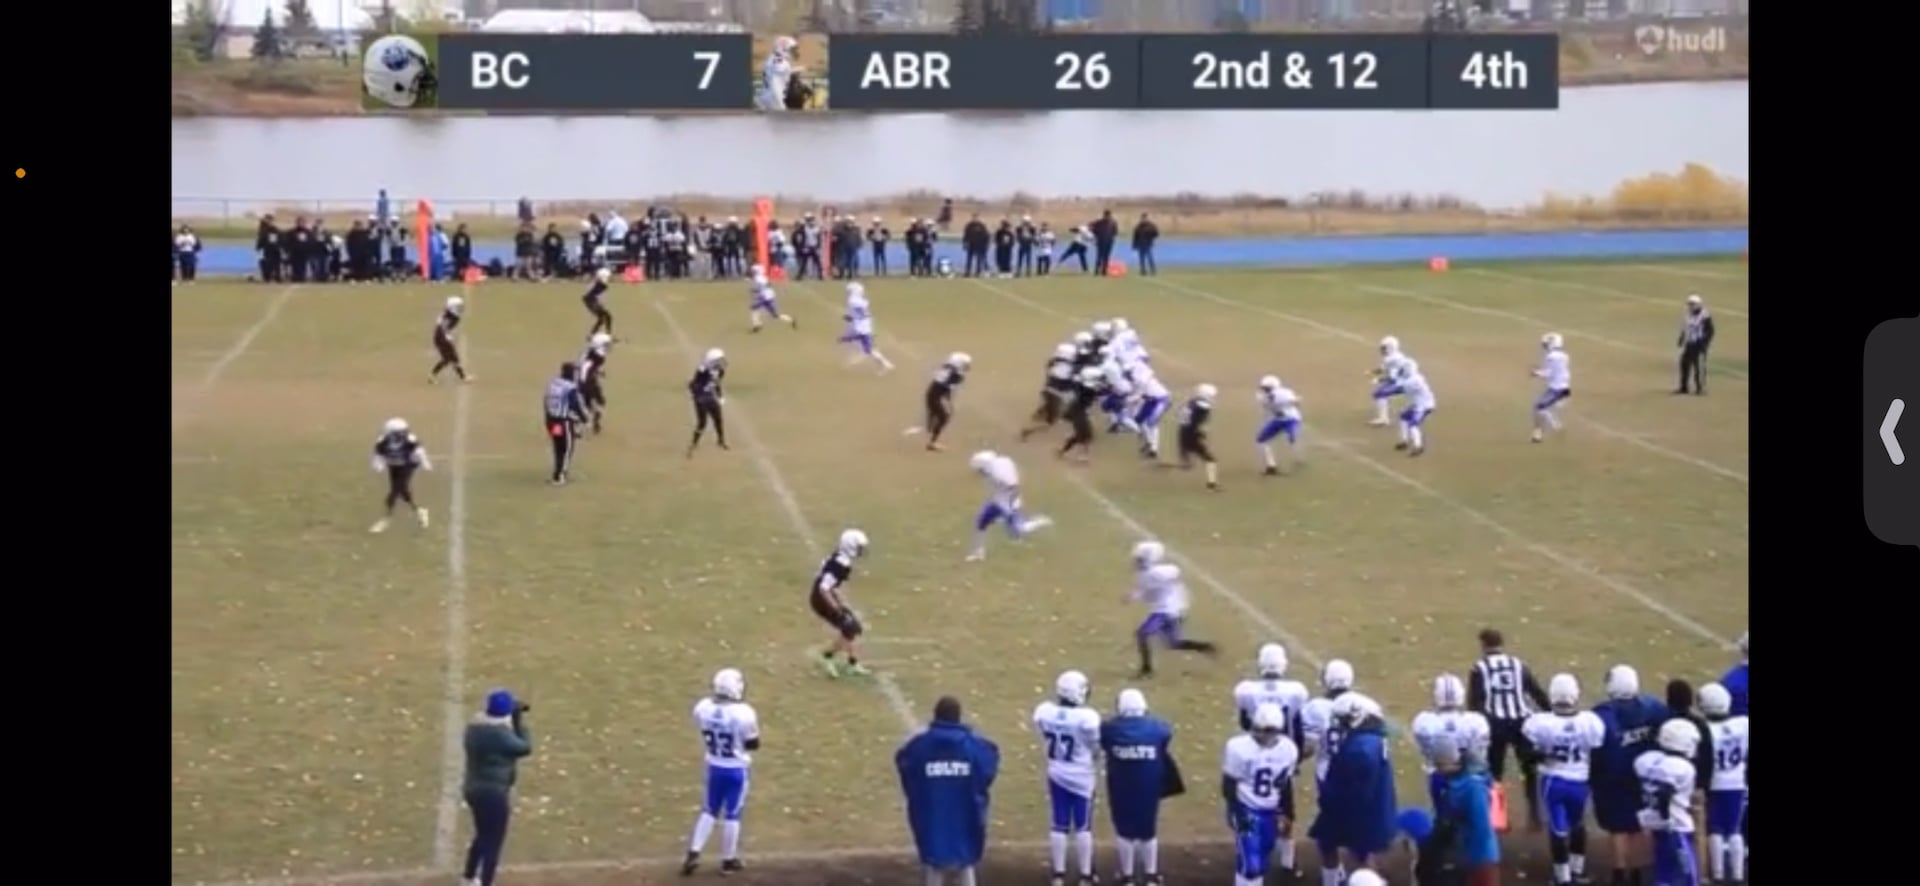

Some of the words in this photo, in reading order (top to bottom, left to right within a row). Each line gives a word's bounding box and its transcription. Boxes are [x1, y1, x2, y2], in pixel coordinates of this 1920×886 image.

[1044, 731, 1074, 761] 77
[1112, 744, 1157, 760] COLTS
[925, 760, 971, 777] COLTS
